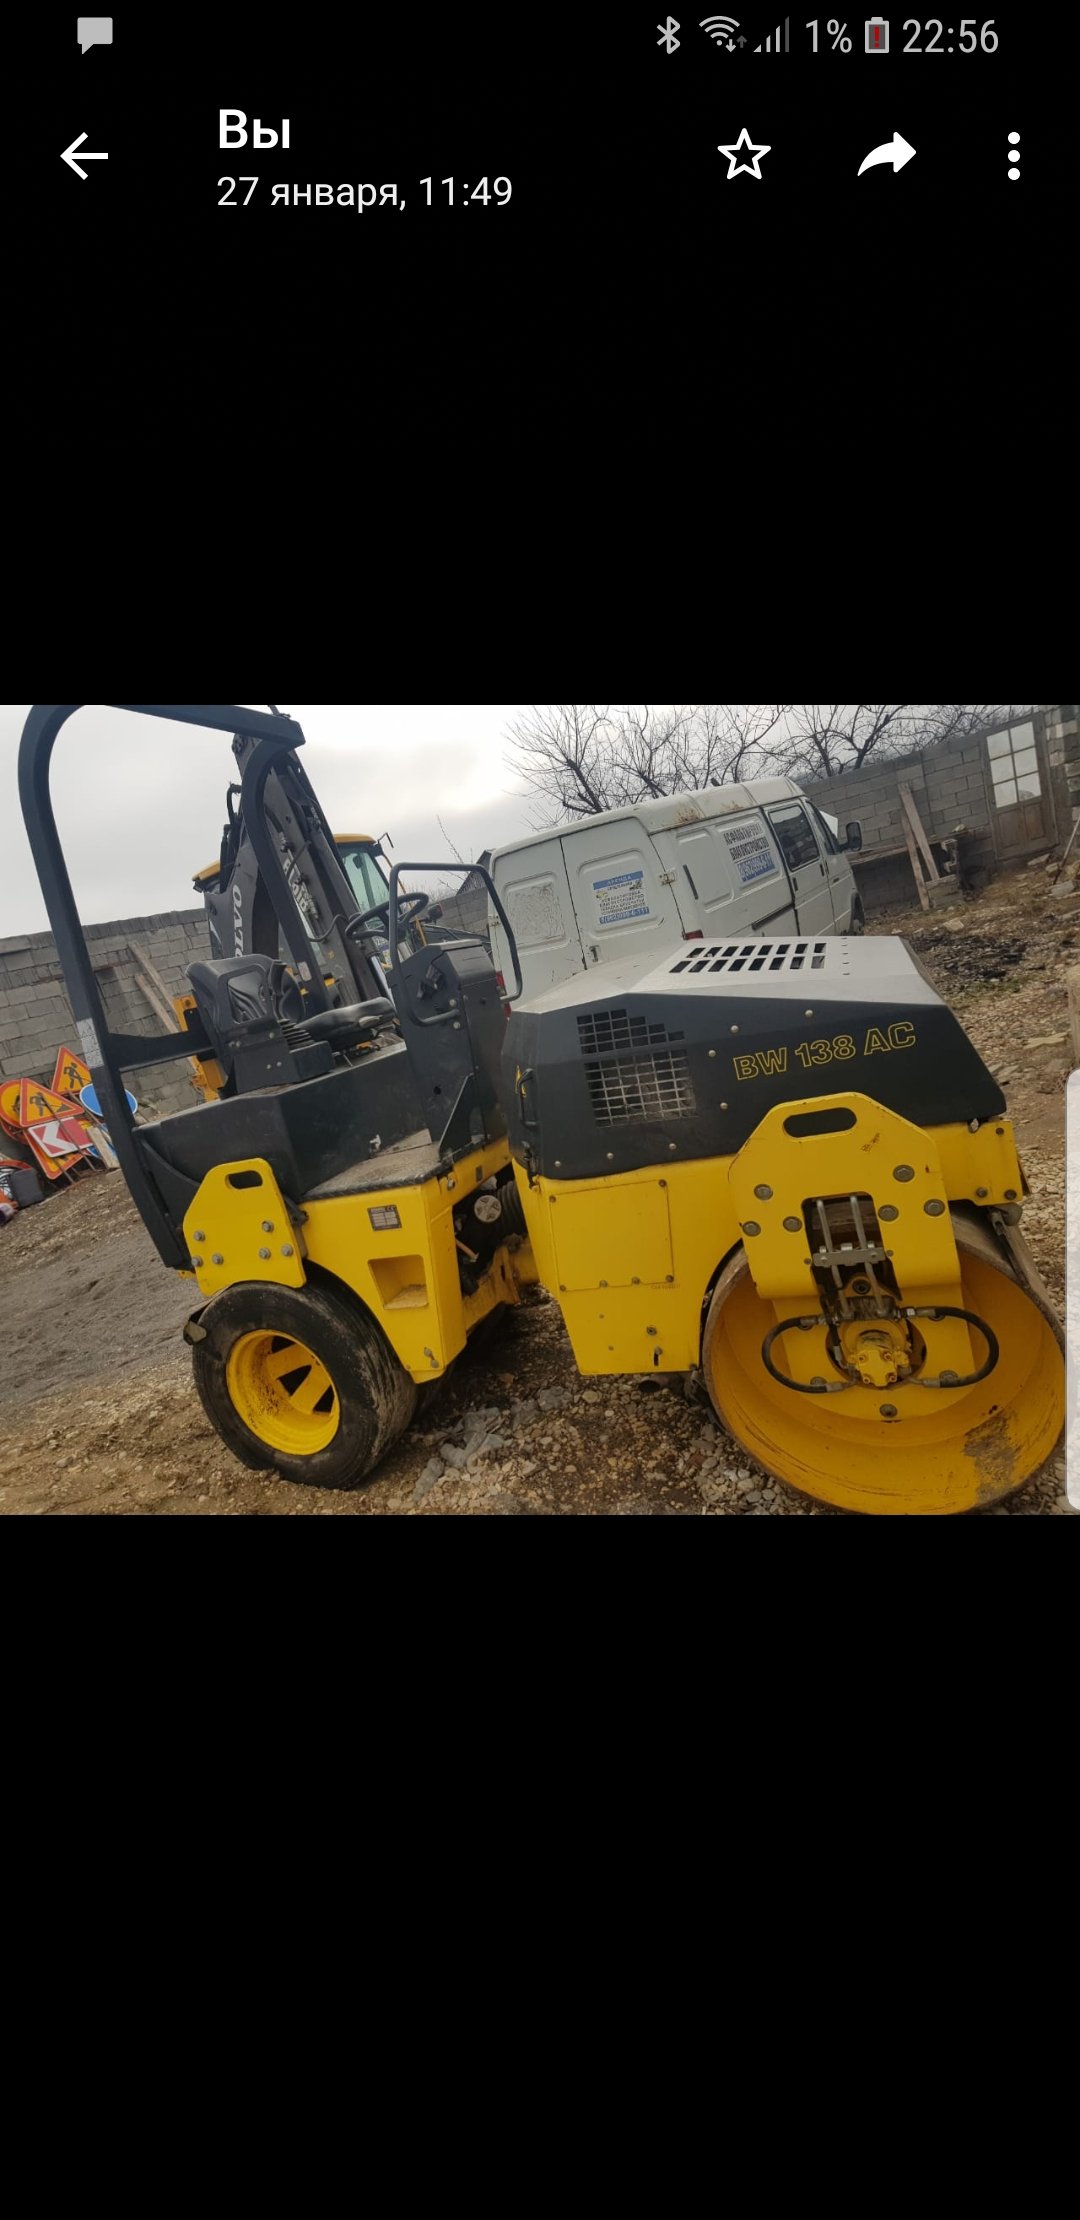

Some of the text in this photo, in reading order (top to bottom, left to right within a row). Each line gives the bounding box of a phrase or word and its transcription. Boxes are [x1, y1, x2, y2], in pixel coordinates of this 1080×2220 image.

[733, 1021, 916, 1081] BW 138 AC
